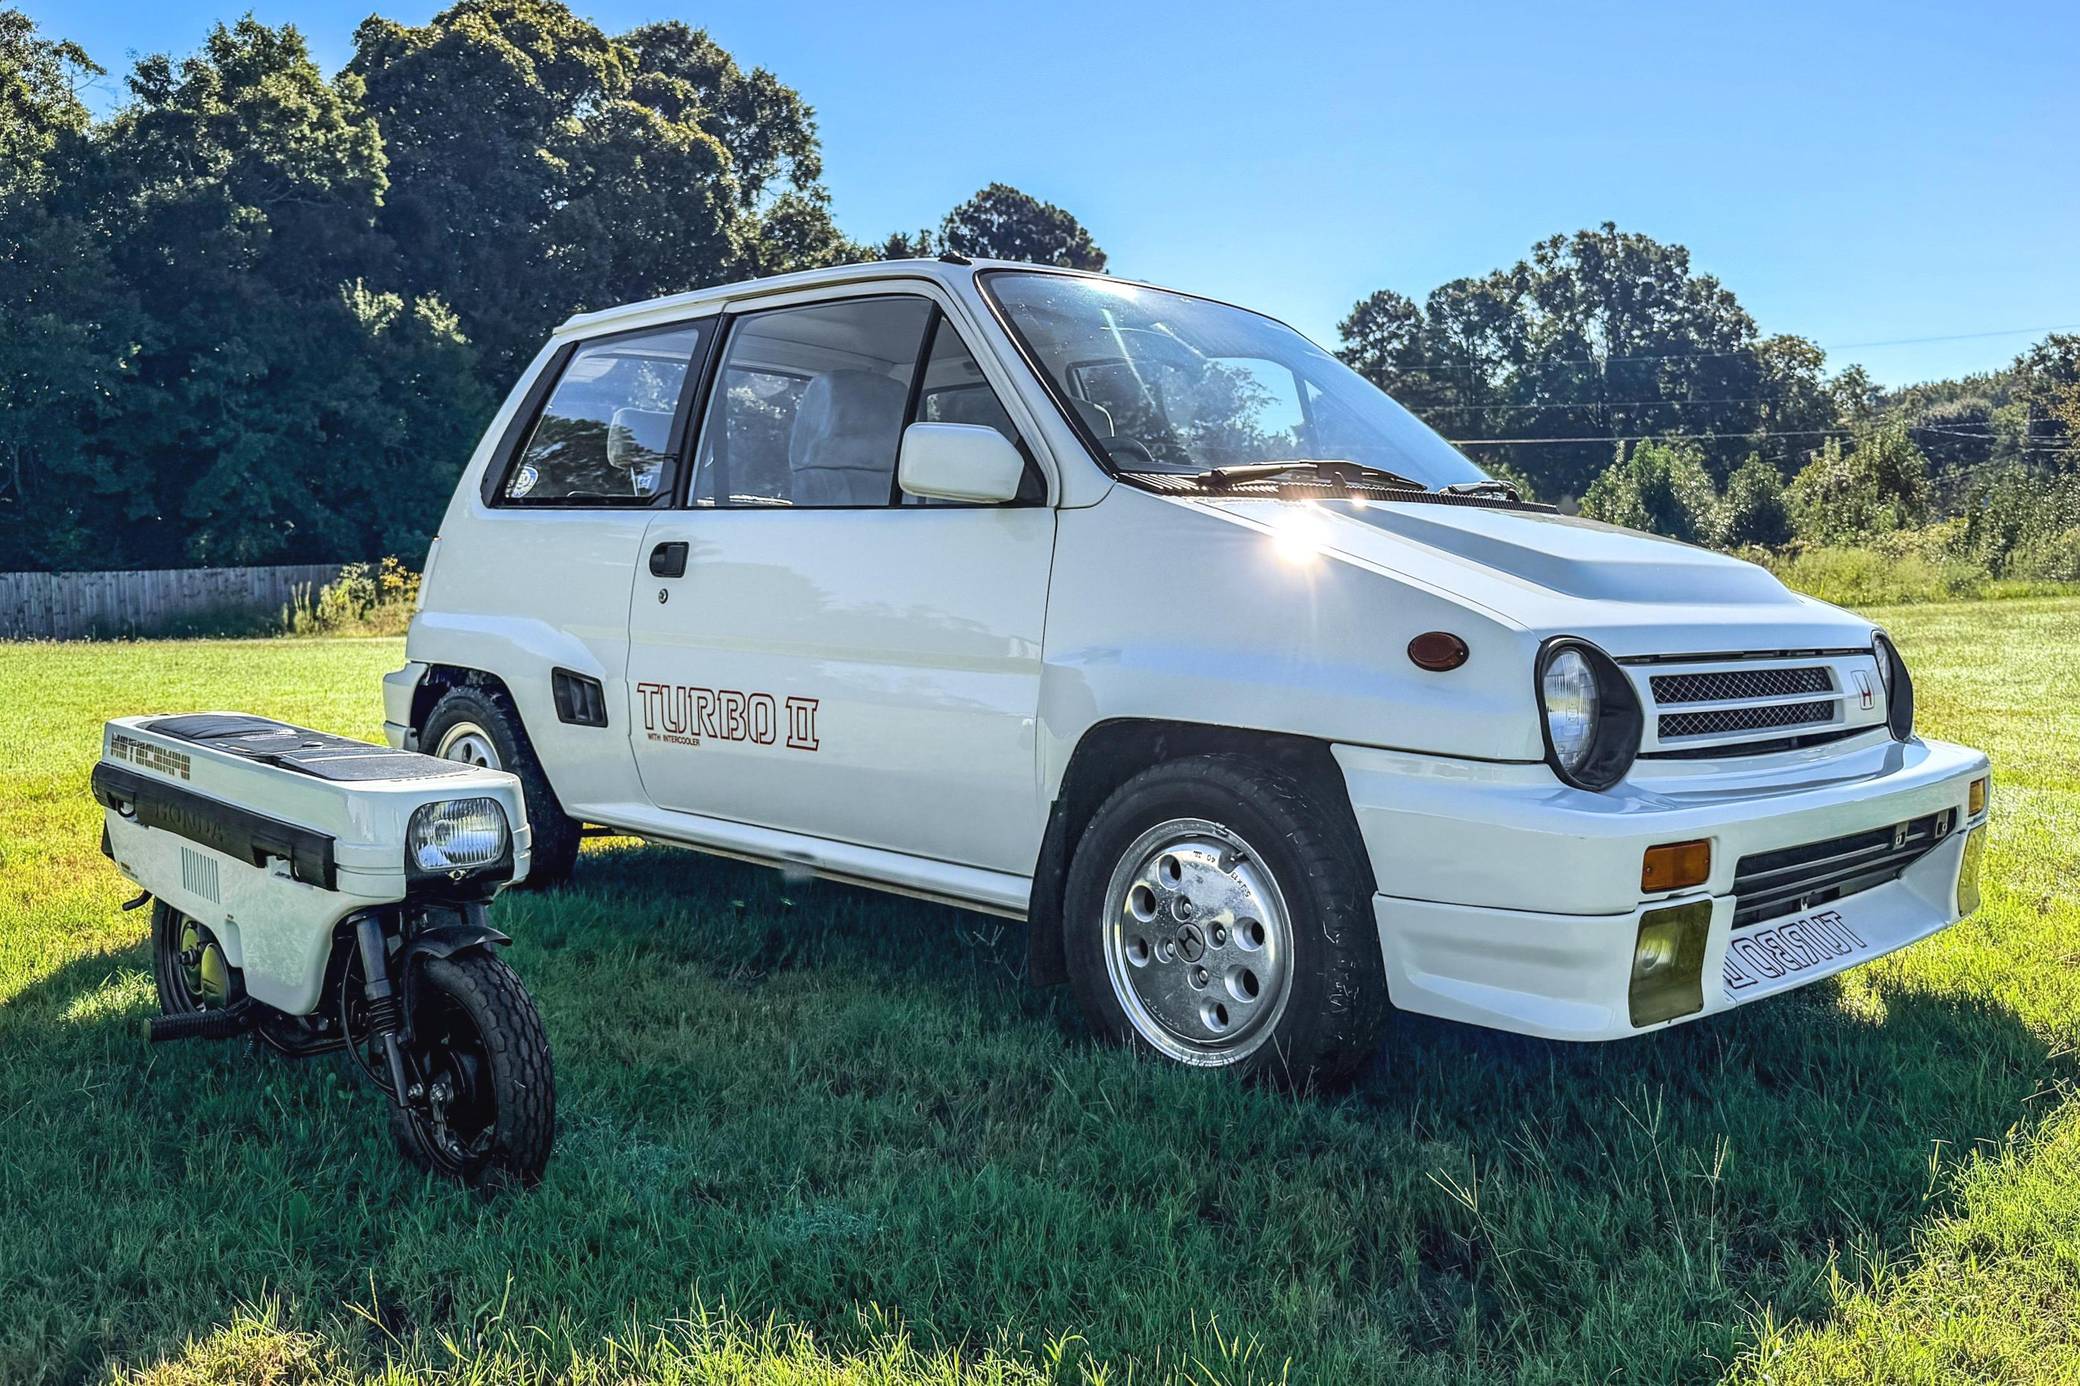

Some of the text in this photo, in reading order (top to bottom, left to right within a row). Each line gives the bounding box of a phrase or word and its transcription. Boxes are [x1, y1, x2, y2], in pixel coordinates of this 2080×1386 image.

[637, 682, 819, 751] TURBO II
[647, 732, 700, 746] WITH INTERCOOLER
[153, 800, 224, 842] HONDA
